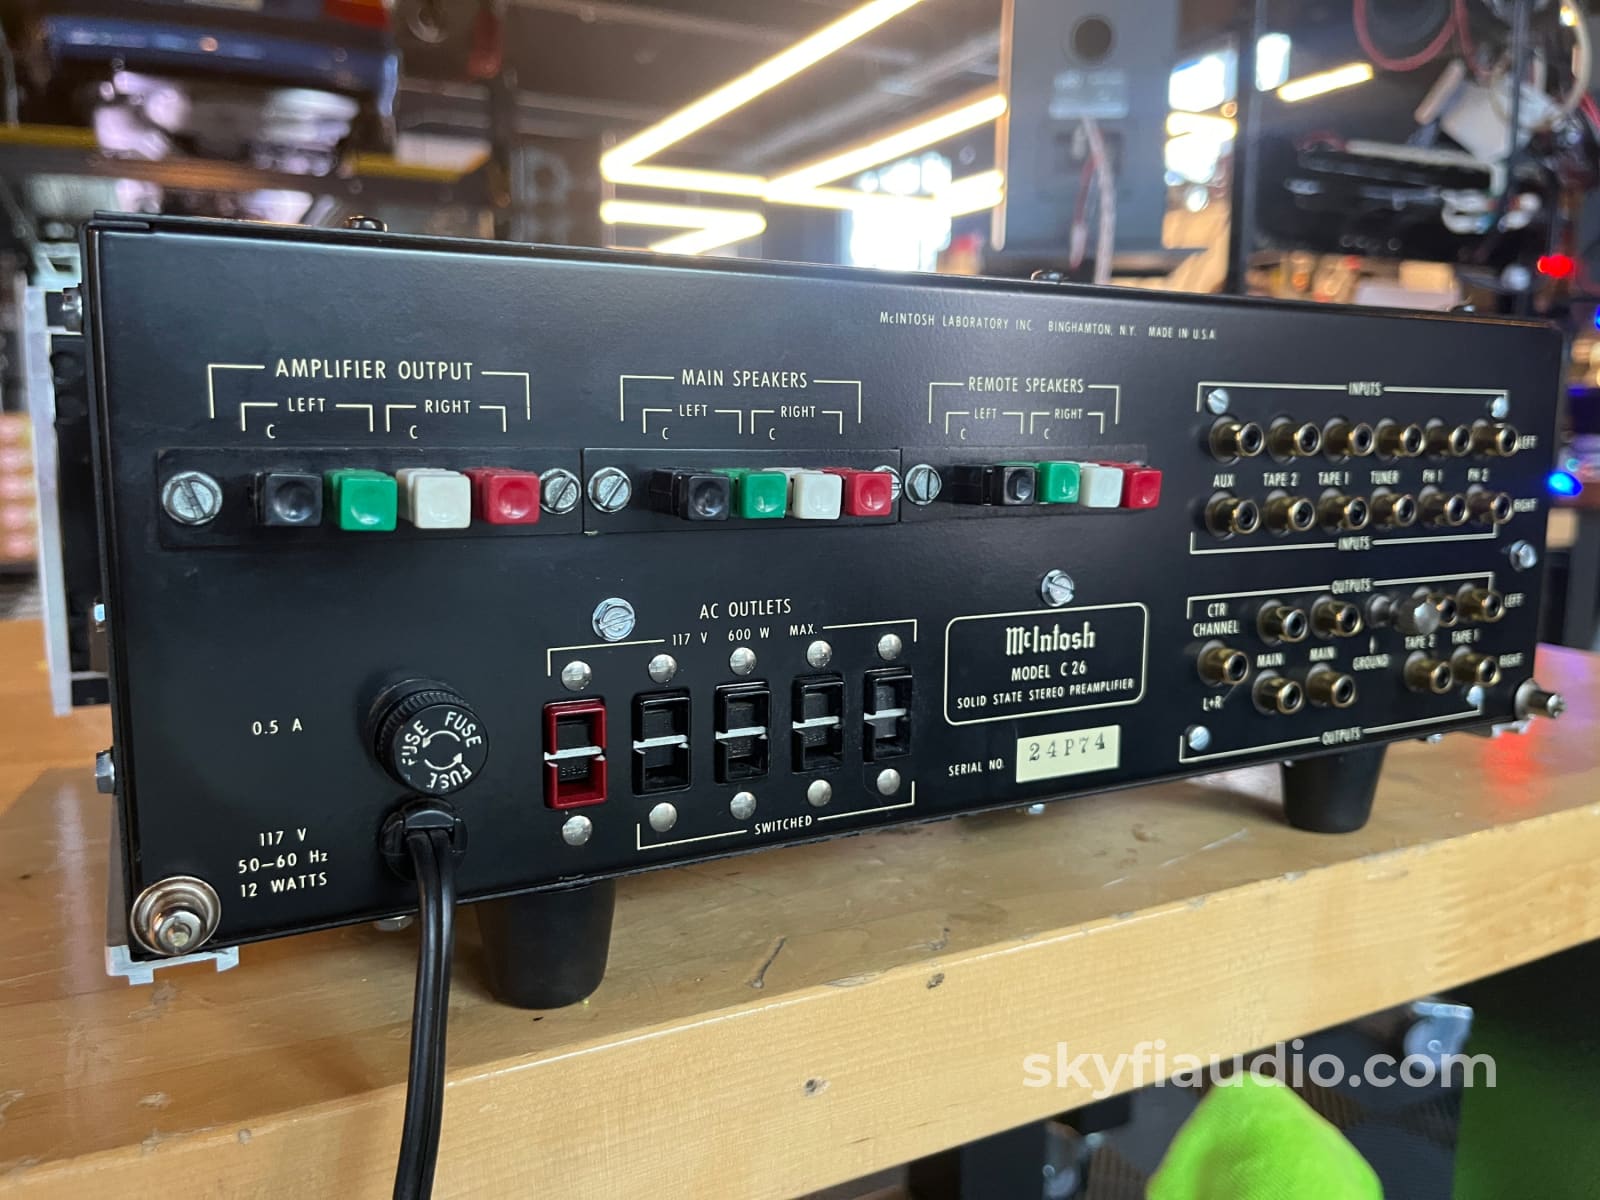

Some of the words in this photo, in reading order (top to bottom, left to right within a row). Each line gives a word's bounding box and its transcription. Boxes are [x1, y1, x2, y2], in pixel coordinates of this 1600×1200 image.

[879, 311, 936, 326] McINTOSH
[942, 315, 1009, 330] LABORATORY
[1048, 320, 1113, 336] BINGHAMTON,
[1148, 325, 1173, 339] MADE
[1178, 327, 1188, 339] IN
[275, 358, 387, 380] AMPLIFIER
[398, 360, 474, 381] OUTPUT
[681, 368, 724, 387] MAIN
[732, 370, 809, 389] SPEAKERS
[968, 376, 1019, 393] REMOTE
[1025, 377, 1085, 394] SPEAKERS
[1347, 381, 1384, 396] INPUTS
[287, 397, 326, 413] LEFT
[424, 399, 472, 415] RIGHT
[679, 404, 708, 417] LEFT
[780, 405, 816, 419] RIGHT
[974, 407, 997, 420] LEFT
[1054, 408, 1083, 420] RIGHT
[266, 424, 276, 440] C
[409, 424, 418, 440] C
[661, 427, 669, 440] C
[768, 427, 776, 441] C
[960, 427, 967, 440] C
[1043, 428, 1050, 440] C
[1212, 473, 1236, 488] AUX
[1263, 471, 1288, 487] TAPE
[1290, 472, 1299, 487] 2
[1318, 471, 1340, 486] TAPE
[1343, 471, 1350, 485] 1
[1370, 469, 1400, 485] TUNER
[1422, 468, 1436, 483] PH
[1467, 467, 1480, 482] PH
[1480, 467, 1490, 482] 2
[1338, 535, 1372, 551] INPUTS
[1331, 578, 1372, 594] OUTPUTS
[699, 602, 720, 620] AC
[728, 598, 792, 618] OUTLETS
[1207, 602, 1228, 618] CTR
[672, 632, 691, 646] 117
[700, 632, 708, 644] V
[728, 628, 751, 642] 600
[759, 626, 770, 639] W
[789, 623, 818, 637] MAX.
[1192, 620, 1241, 638] CHANNEL
[1451, 629, 1473, 645] TAPE
[1005, 620, 1097, 656] McIntosh
[1404, 634, 1427, 650] TAPE
[1256, 652, 1285, 668] MAIN
[1309, 646, 1338, 662] MAIN
[1352, 653, 1391, 671] GROUND
[1011, 663, 1051, 682] MODEL
[1060, 661, 1068, 676] C
[1071, 660, 1088, 675] 26
[956, 695, 988, 710] SOLID
[992, 689, 1023, 705] STATE
[1028, 685, 1065, 701] STEREO
[1069, 678, 1135, 696] PREAMPLIFIER
[1202, 695, 1225, 711] L+R
[252, 720, 279, 736] 0.5
[292, 717, 303, 732] A
[445, 711, 482, 748] FUSE
[1321, 726, 1363, 746] OUTPUTS
[1028, 732, 1106, 762] 24P74
[426, 763, 472, 789] FUSE
[948, 762, 983, 777] SERIAL
[754, 814, 813, 835] SWITCHED
[259, 830, 284, 847] 117
[296, 827, 307, 842] V
[309, 849, 329, 864] Hz
[240, 882, 258, 898] 12
[270, 871, 328, 893] WATTS
